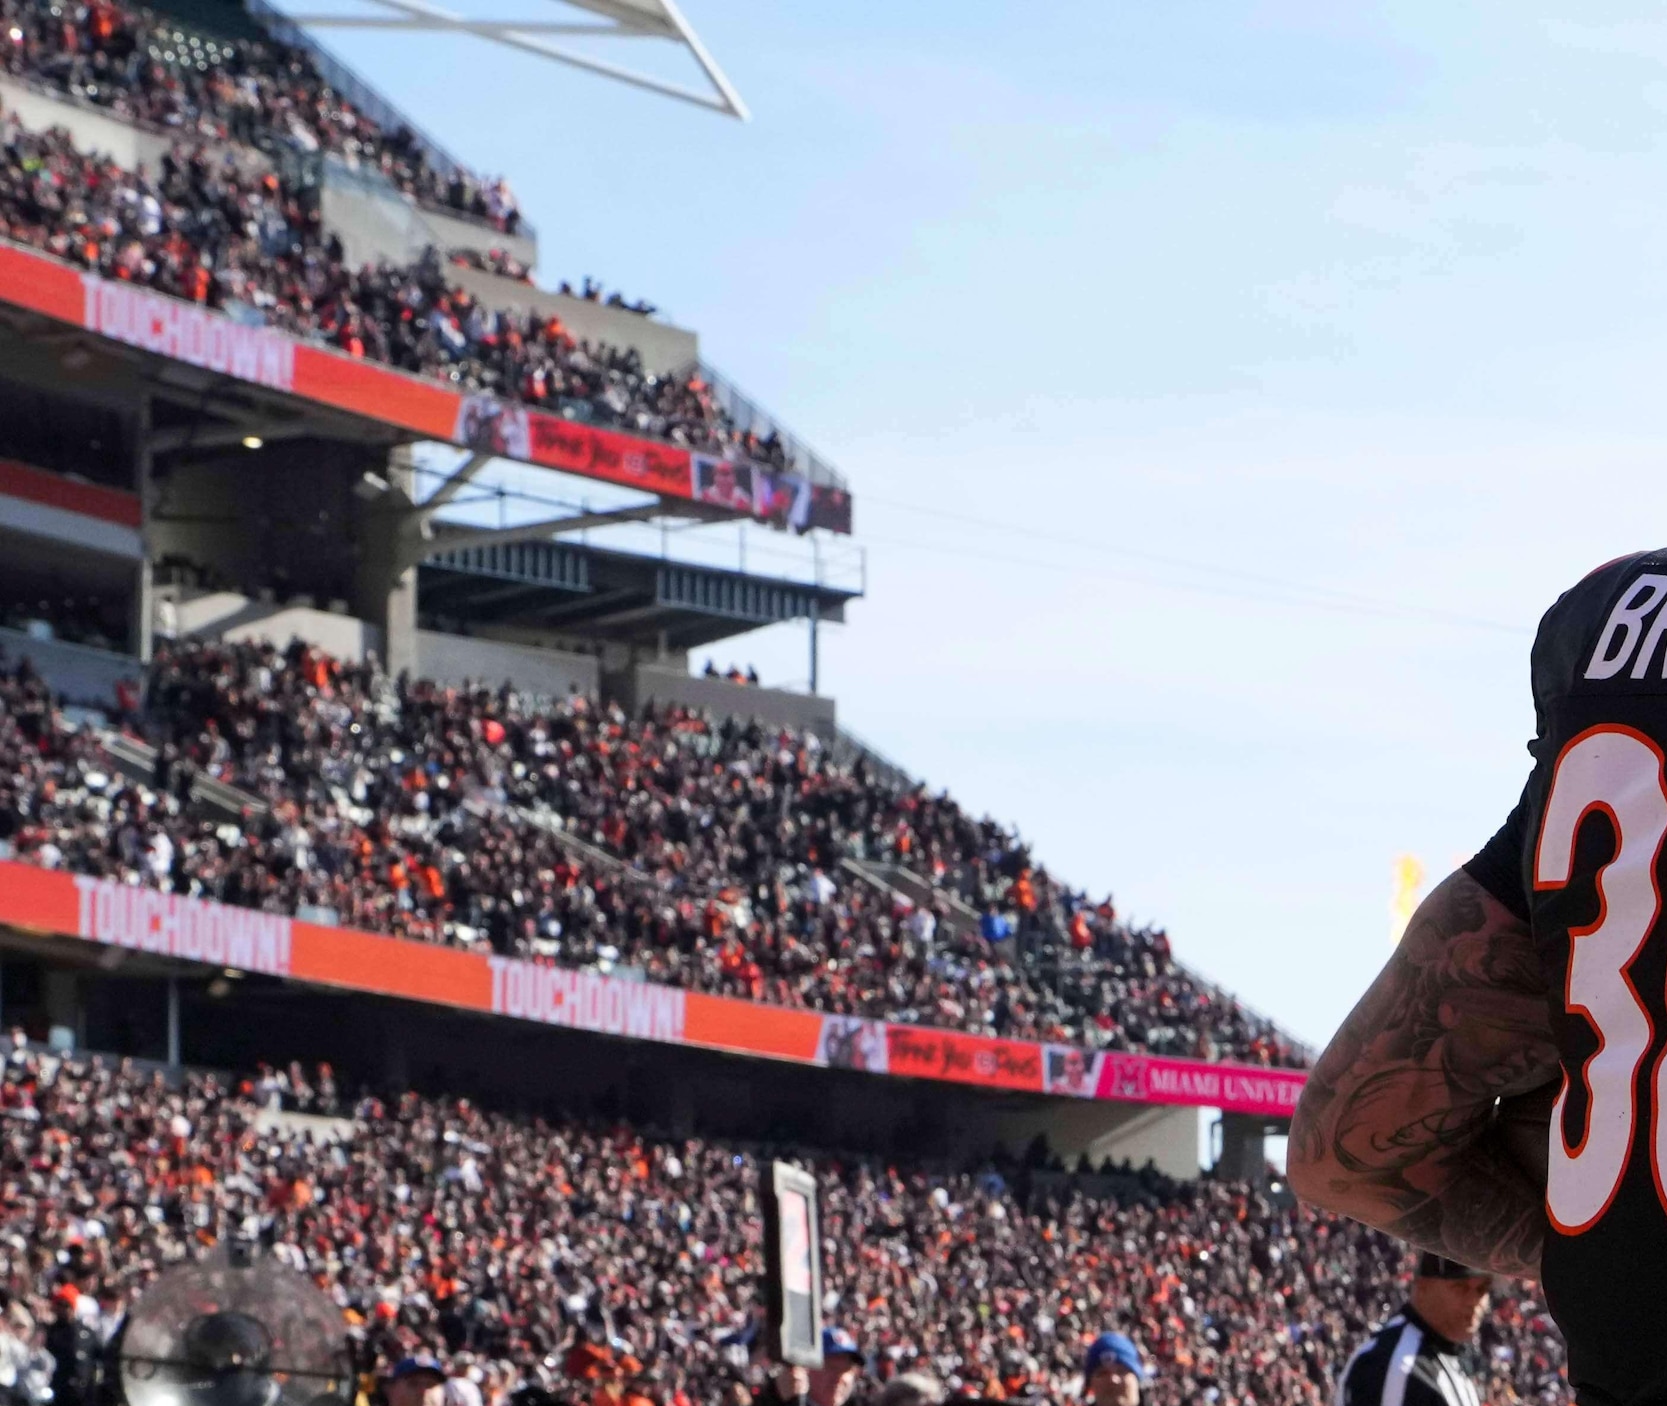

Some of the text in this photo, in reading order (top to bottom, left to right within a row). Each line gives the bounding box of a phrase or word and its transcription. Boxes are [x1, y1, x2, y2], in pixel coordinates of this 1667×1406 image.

[79, 273, 294, 391] TOUCHDOWN!
[73, 874, 292, 977] TOUCHDOWN!
[487, 954, 687, 1040] TOUCHDOWN!
[1151, 1067, 1219, 1097] MIAMI
